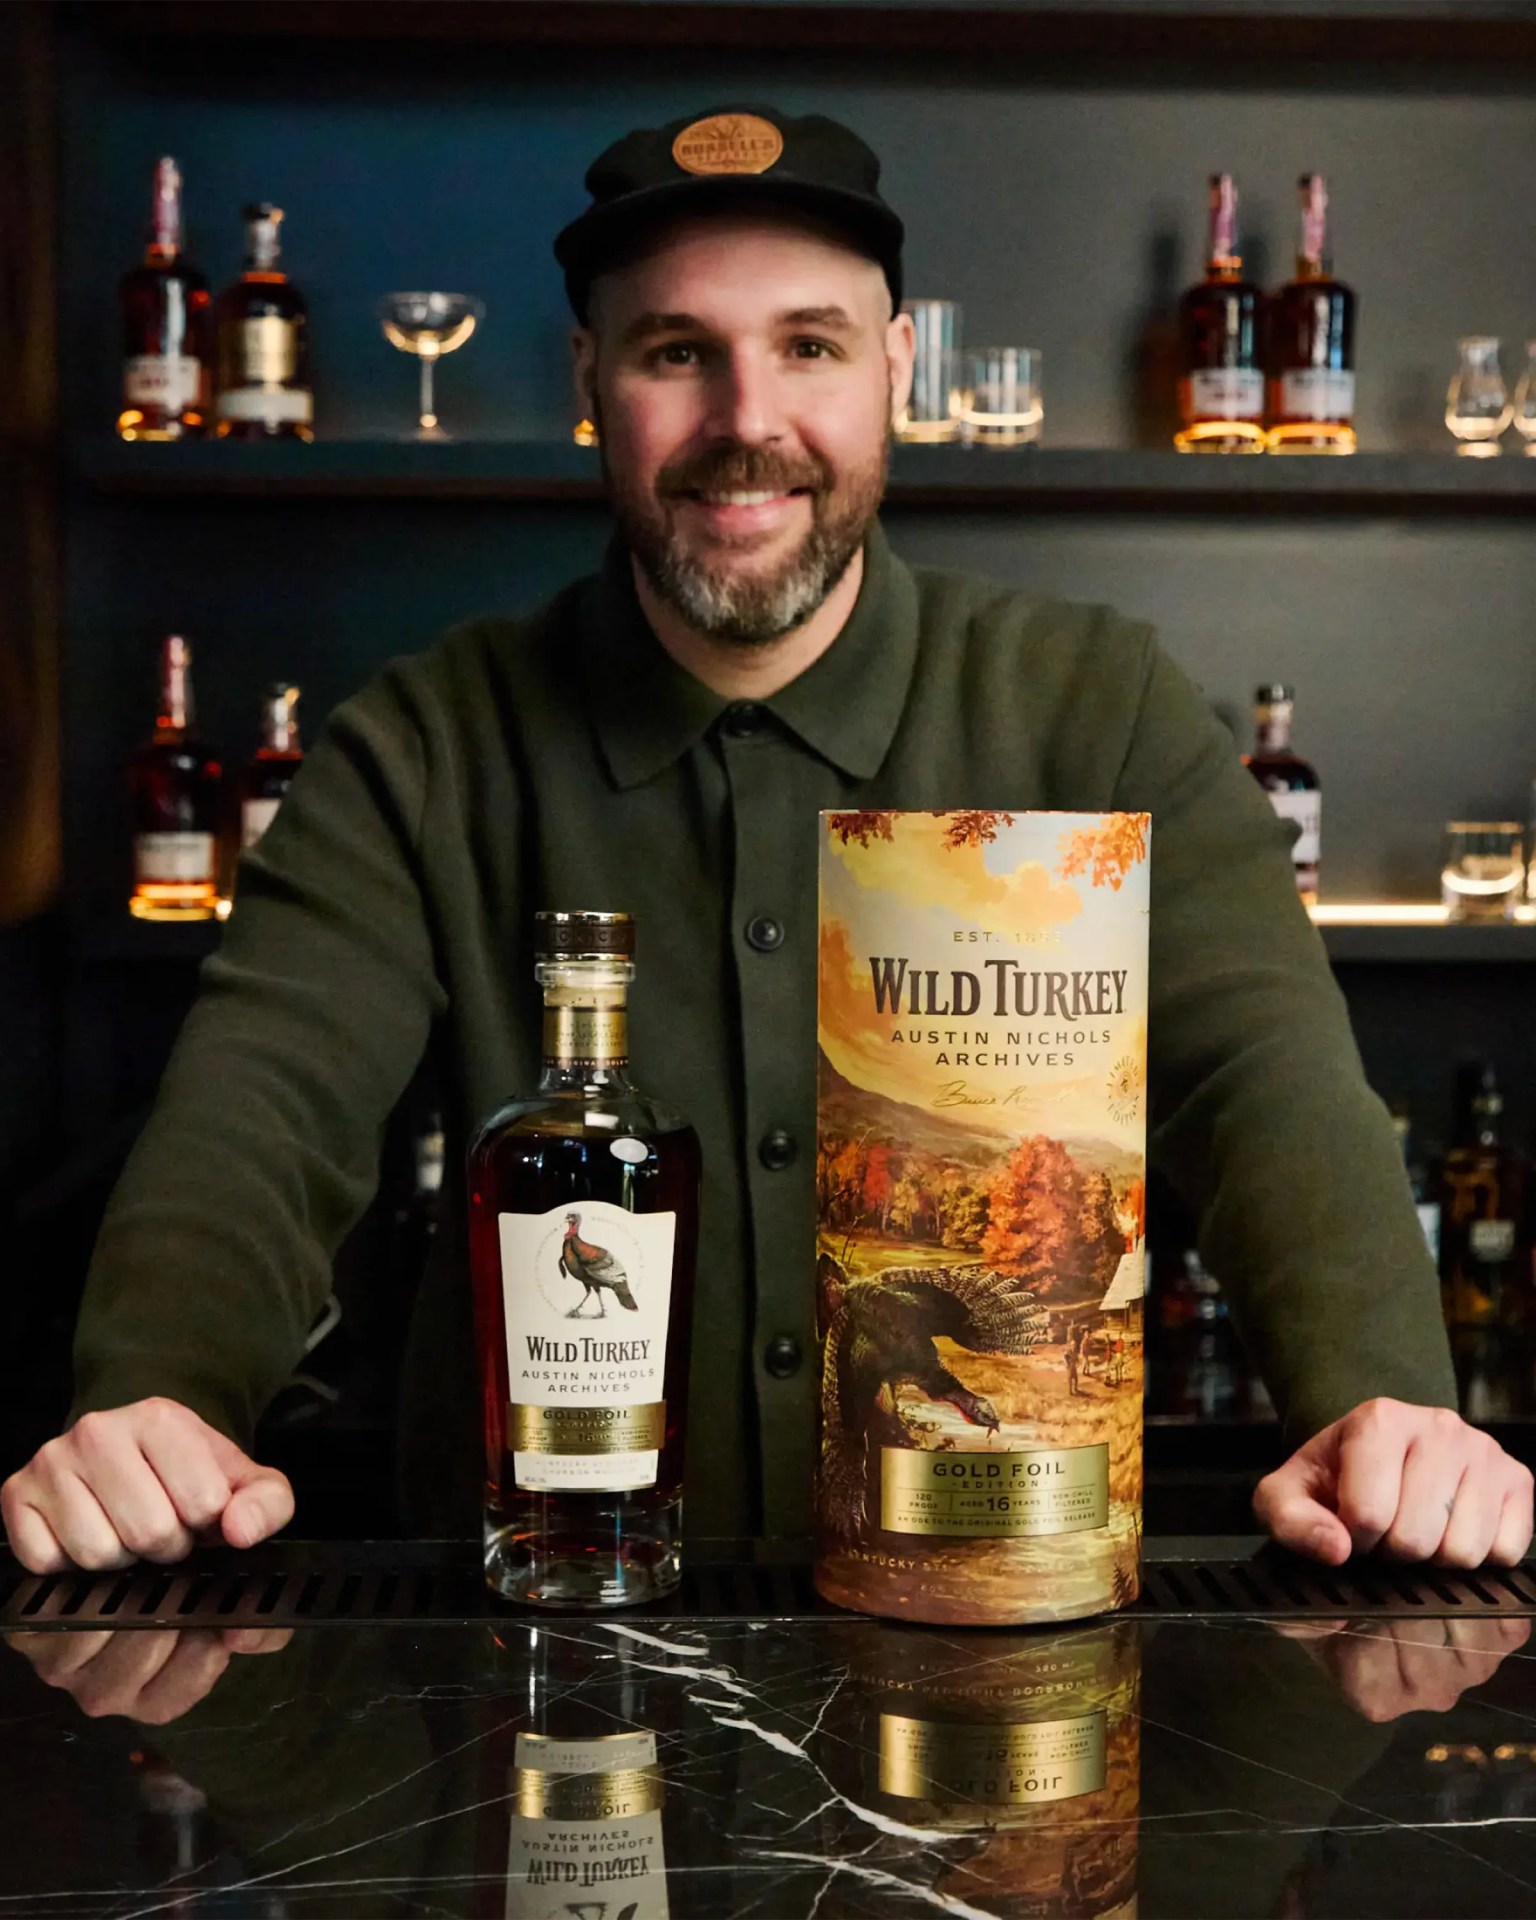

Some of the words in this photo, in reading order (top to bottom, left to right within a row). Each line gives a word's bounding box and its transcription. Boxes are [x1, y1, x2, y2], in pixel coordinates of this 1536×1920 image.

[953, 931, 1000, 943] EST.
[868, 957, 981, 1016] WILD
[985, 960, 1128, 1021] TURKEY
[891, 1030, 989, 1045] AUSTIN
[1007, 1030, 1111, 1045] NICHOLS
[936, 1053, 1074, 1066] ARCHIVES
[526, 1336, 578, 1362] WILD
[579, 1338, 650, 1364] TURKEY
[522, 1370, 579, 1380] AUSTIN
[589, 1368, 654, 1380] NICHOLS
[548, 1383, 630, 1393] ARCHIVES
[543, 1410, 588, 1420] GOLD
[594, 1410, 632, 1419] FOIL
[933, 1463, 1000, 1478] GOLD
[1012, 1462, 1066, 1477] FOIL
[962, 1481, 1039, 1489] EDITION
[987, 1497, 1010, 1511] 16
[1064, 1512, 1095, 1521] RELEASE
